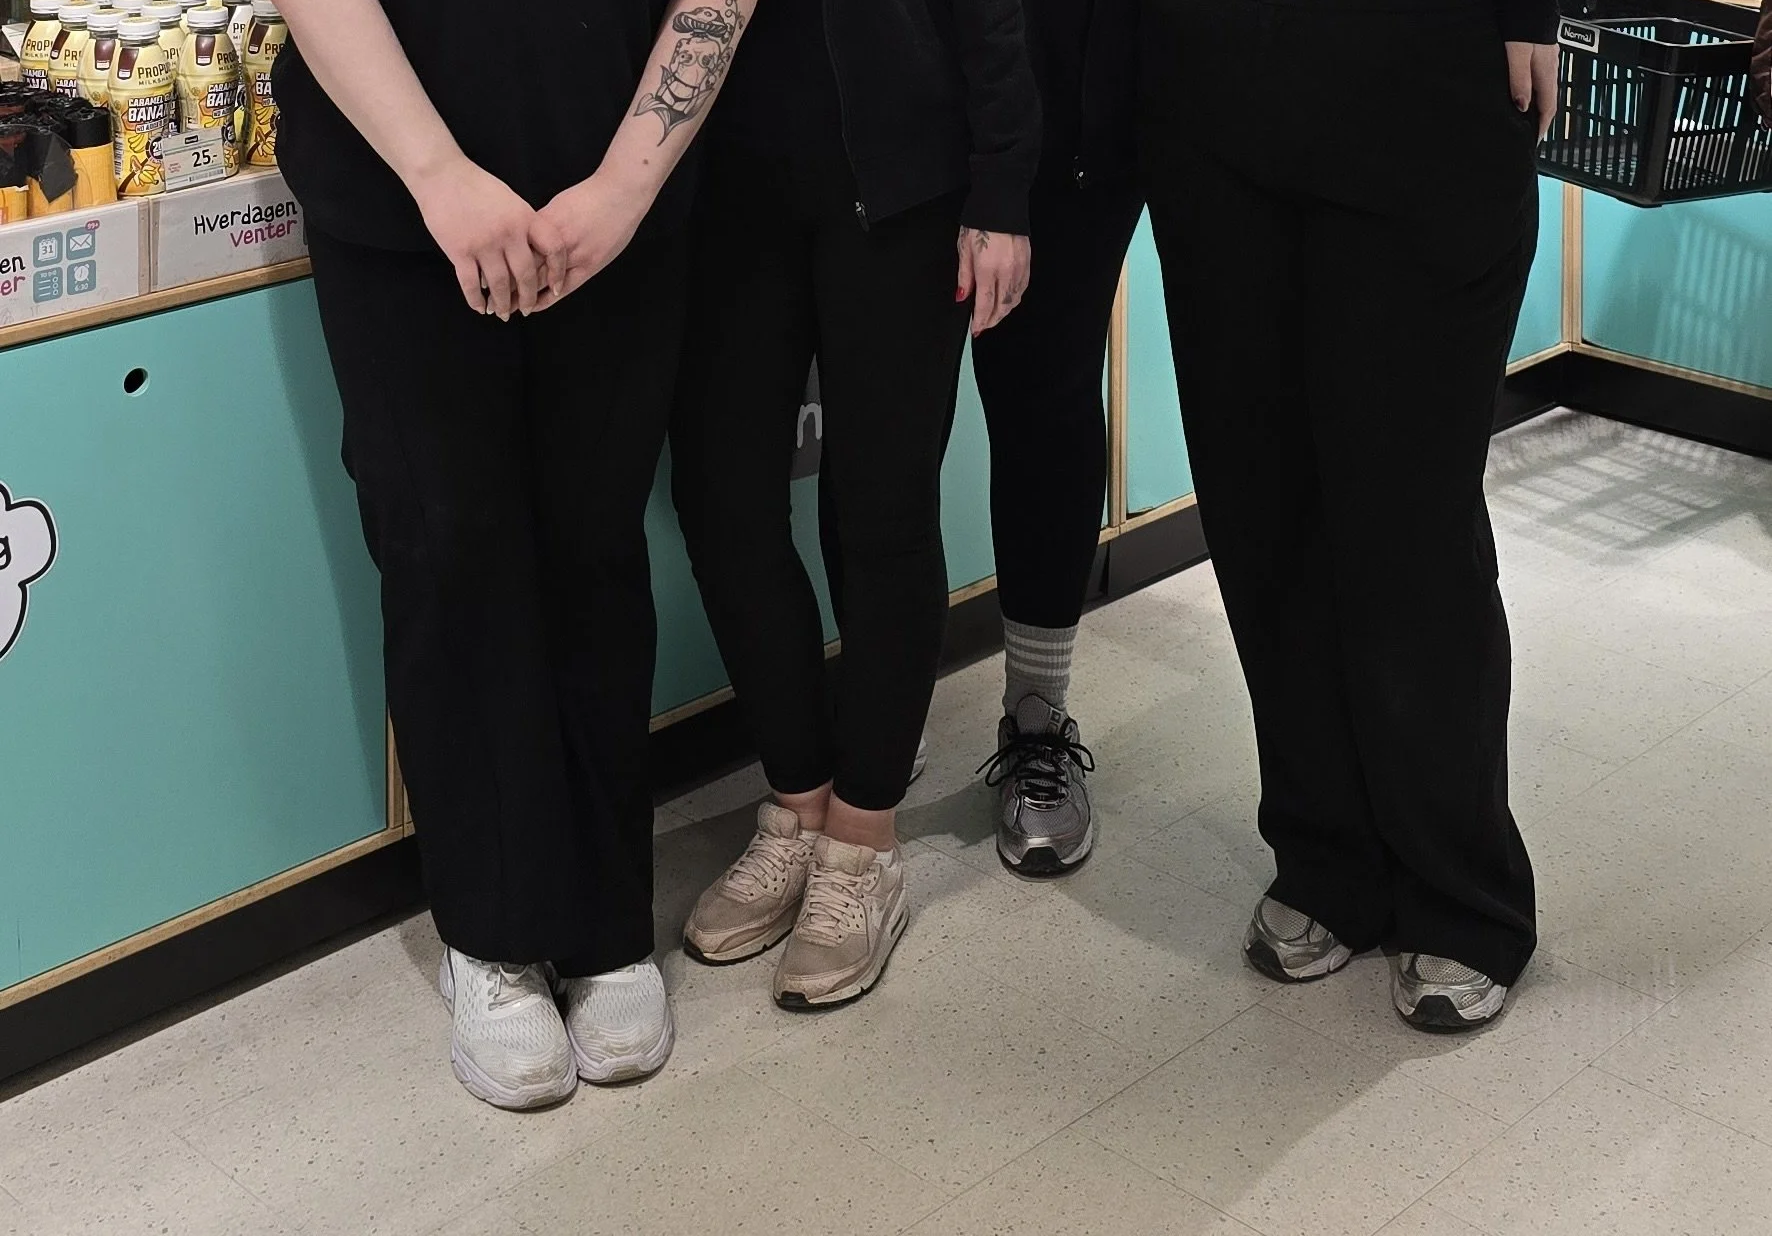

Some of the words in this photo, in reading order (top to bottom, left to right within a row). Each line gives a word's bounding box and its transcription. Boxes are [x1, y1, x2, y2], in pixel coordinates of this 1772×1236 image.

[1563, 26, 1592, 43] Normal
[191, 148, 218, 168] 25,-
[193, 201, 298, 236] Hverdagen
[230, 219, 298, 248] venter
[41, 245, 54, 255] 31
[0, 255, 26, 274] en
[0, 275, 26, 296] er
